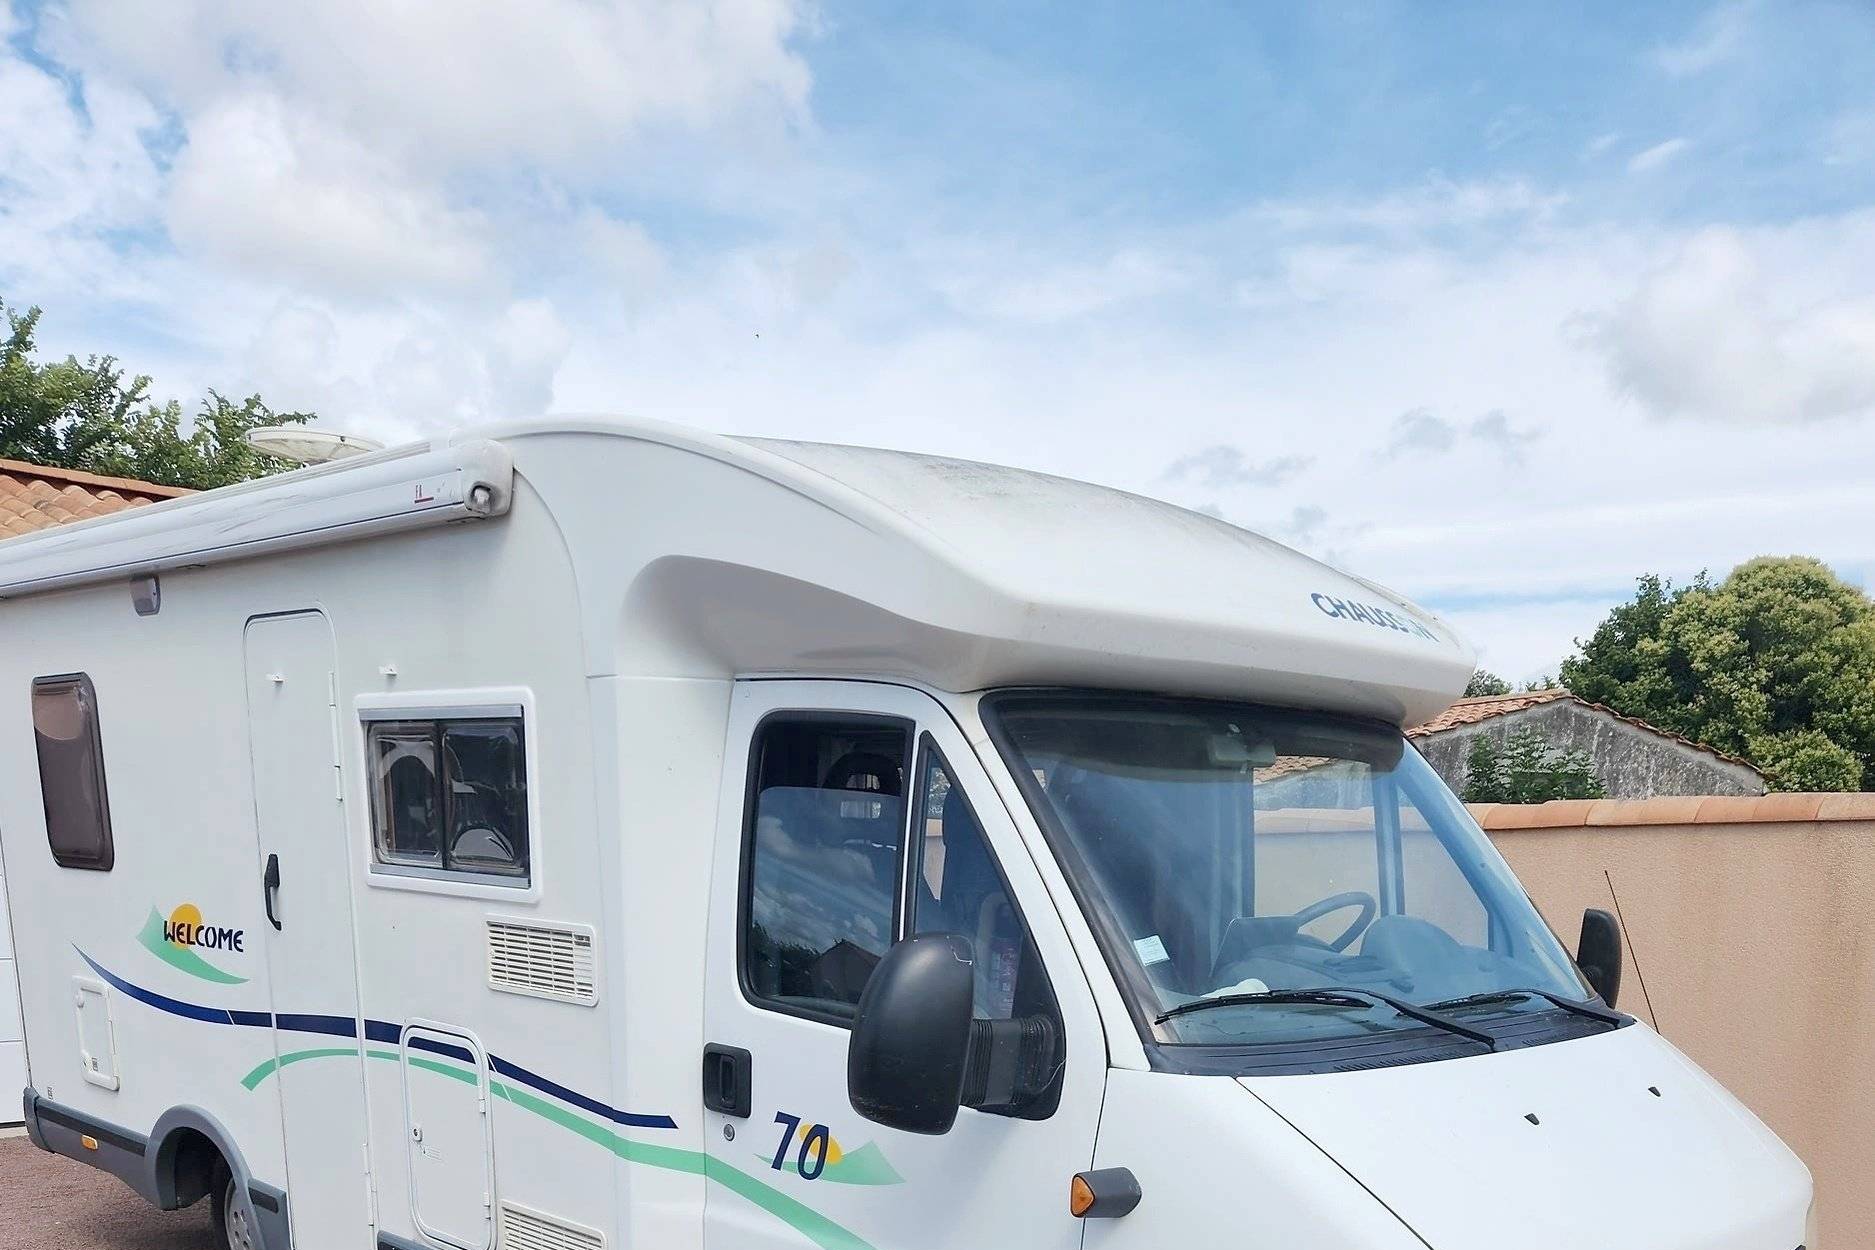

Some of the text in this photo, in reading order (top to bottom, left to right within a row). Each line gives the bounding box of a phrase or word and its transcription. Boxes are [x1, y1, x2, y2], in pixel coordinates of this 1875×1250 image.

[1310, 592, 1441, 643] CHAUSSN
[163, 920, 244, 953] WELCOME
[771, 1110, 830, 1181] 70
